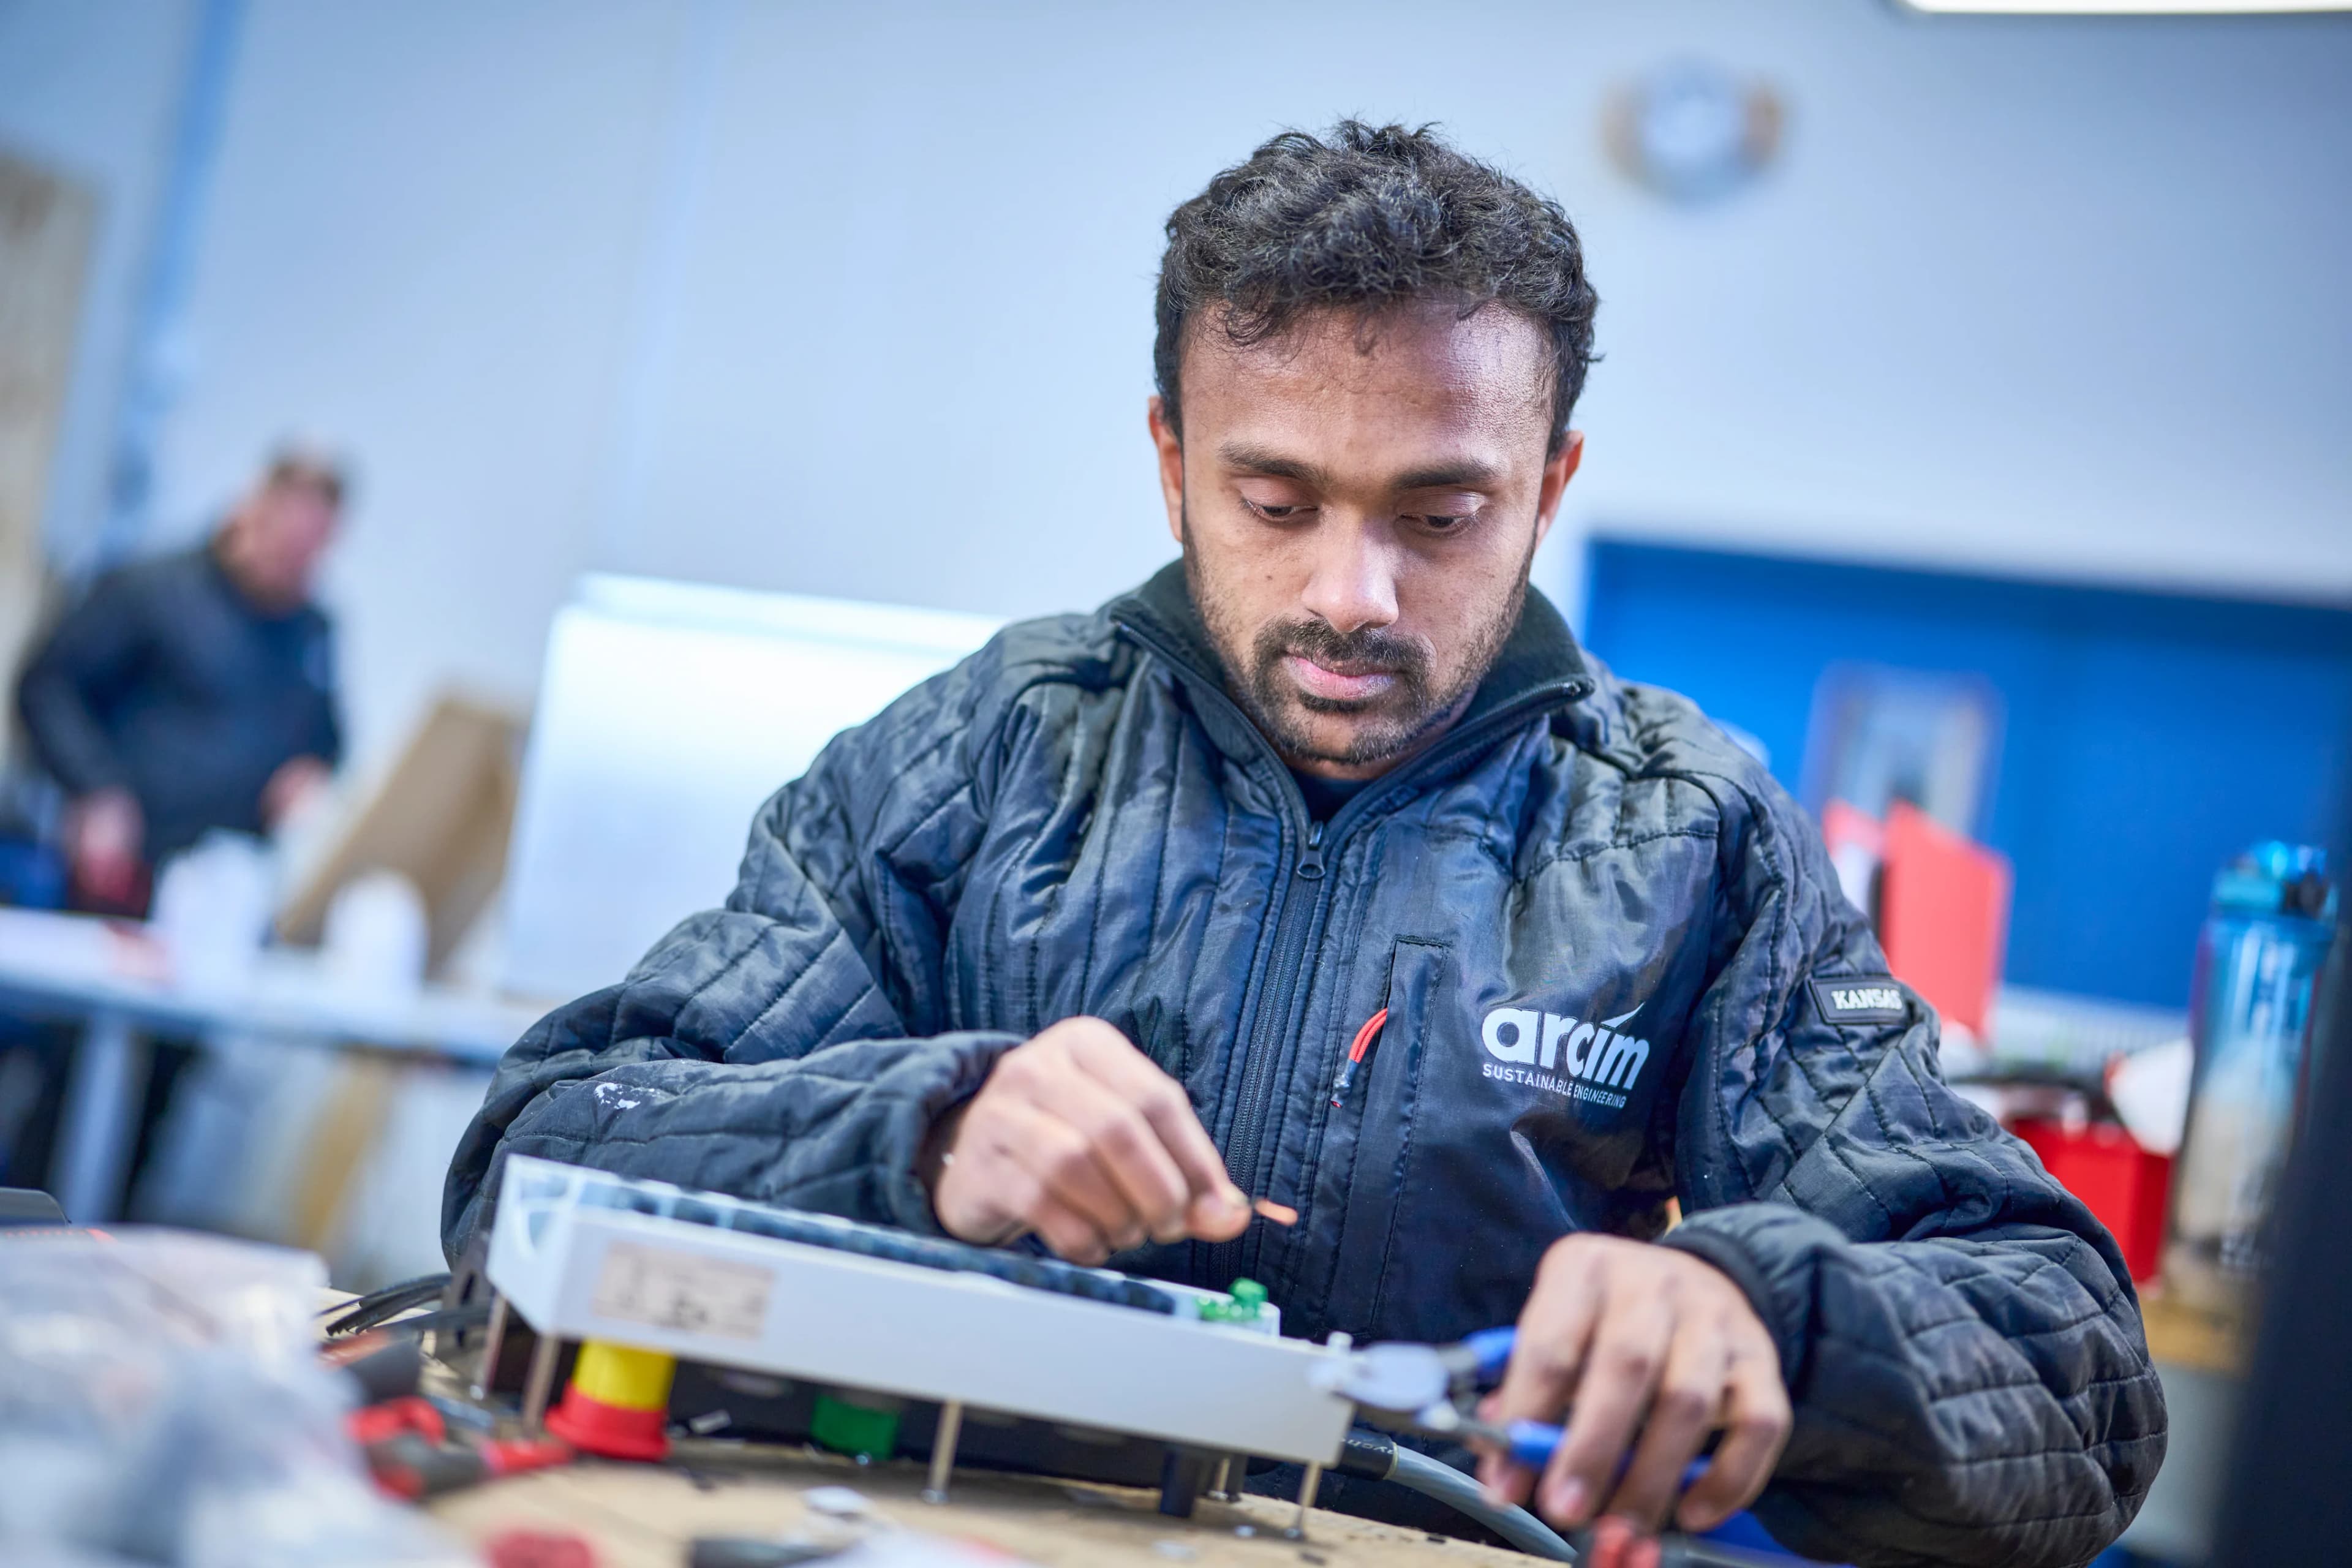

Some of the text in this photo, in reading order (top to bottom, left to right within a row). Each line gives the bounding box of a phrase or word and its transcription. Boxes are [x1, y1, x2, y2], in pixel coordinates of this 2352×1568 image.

[1831, 989, 1902, 1010] KANSAS
[1482, 1063, 1627, 1109] SUSTAINABLE ENGINEERING
